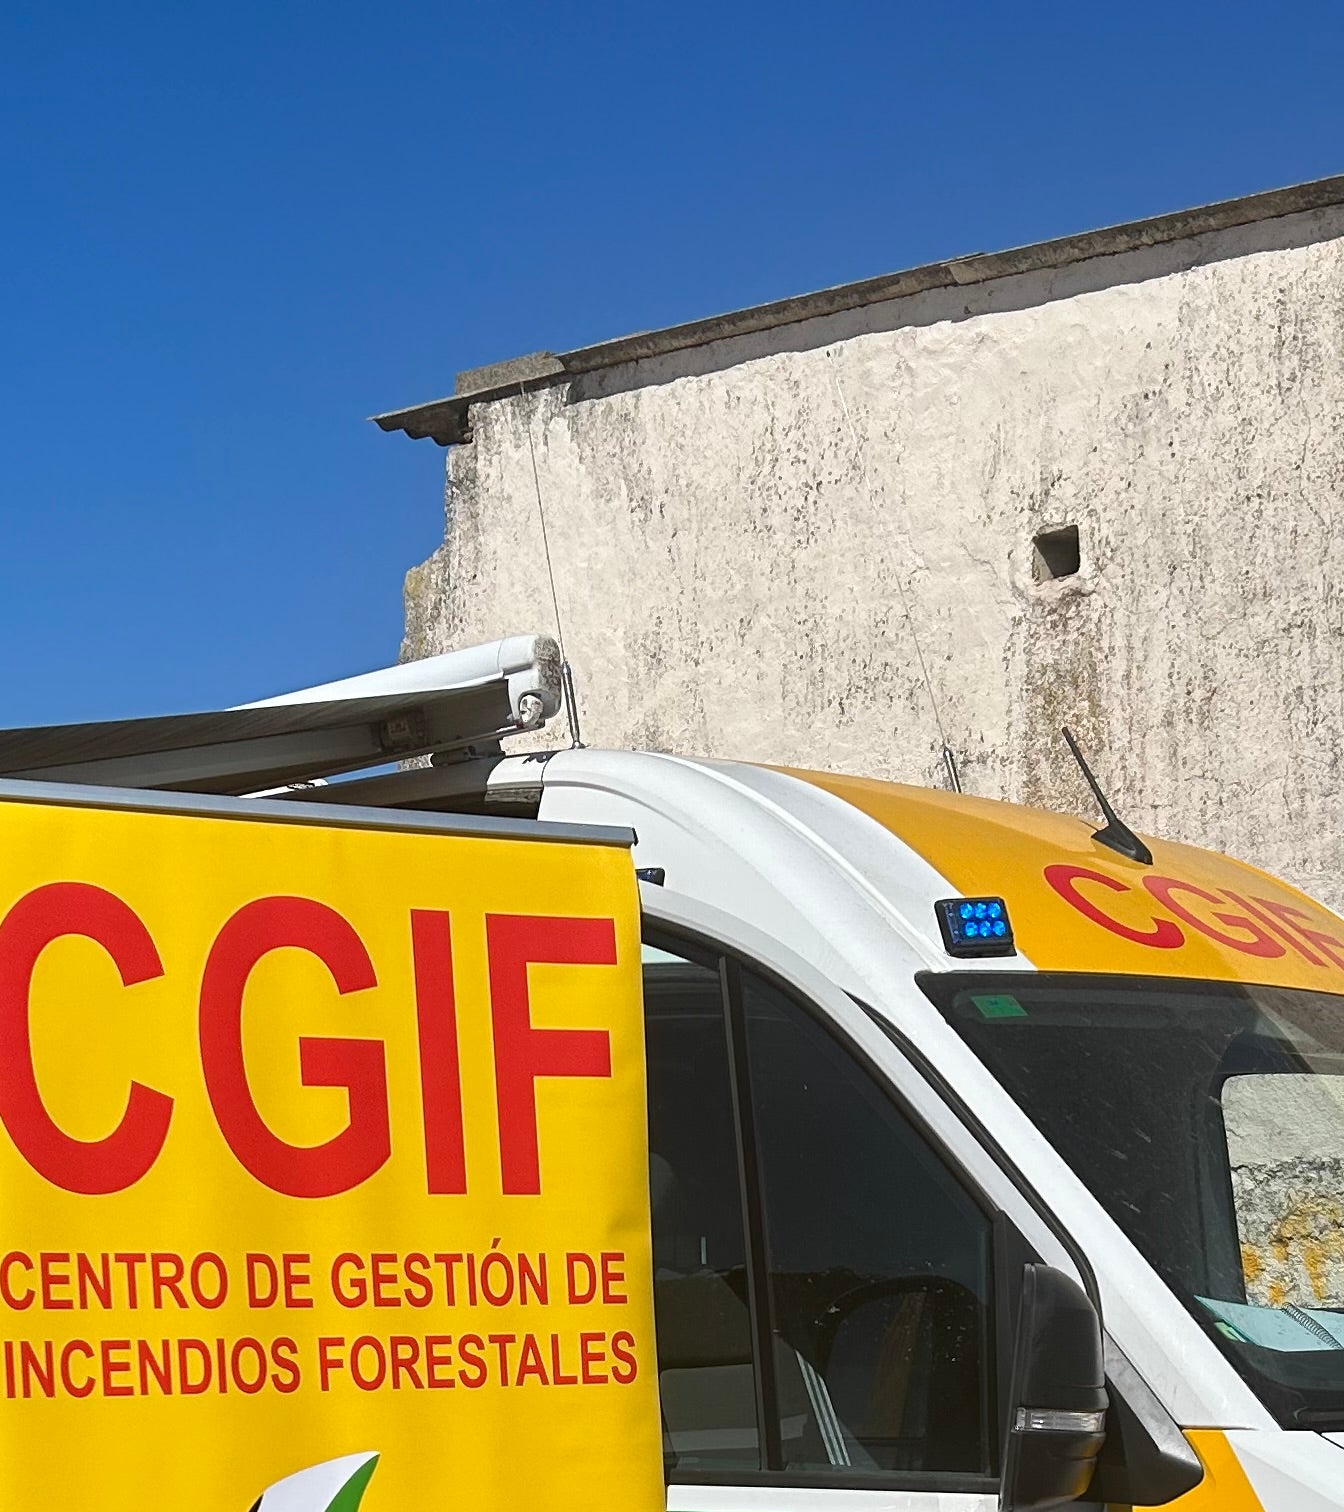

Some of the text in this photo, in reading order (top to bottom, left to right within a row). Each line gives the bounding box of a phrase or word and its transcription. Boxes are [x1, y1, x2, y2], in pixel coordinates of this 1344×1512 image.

[0, 1238, 629, 1309] CENTRO DE GESTIÓN DE
[4, 1331, 638, 1399] INCENDIOS FORESTALES
